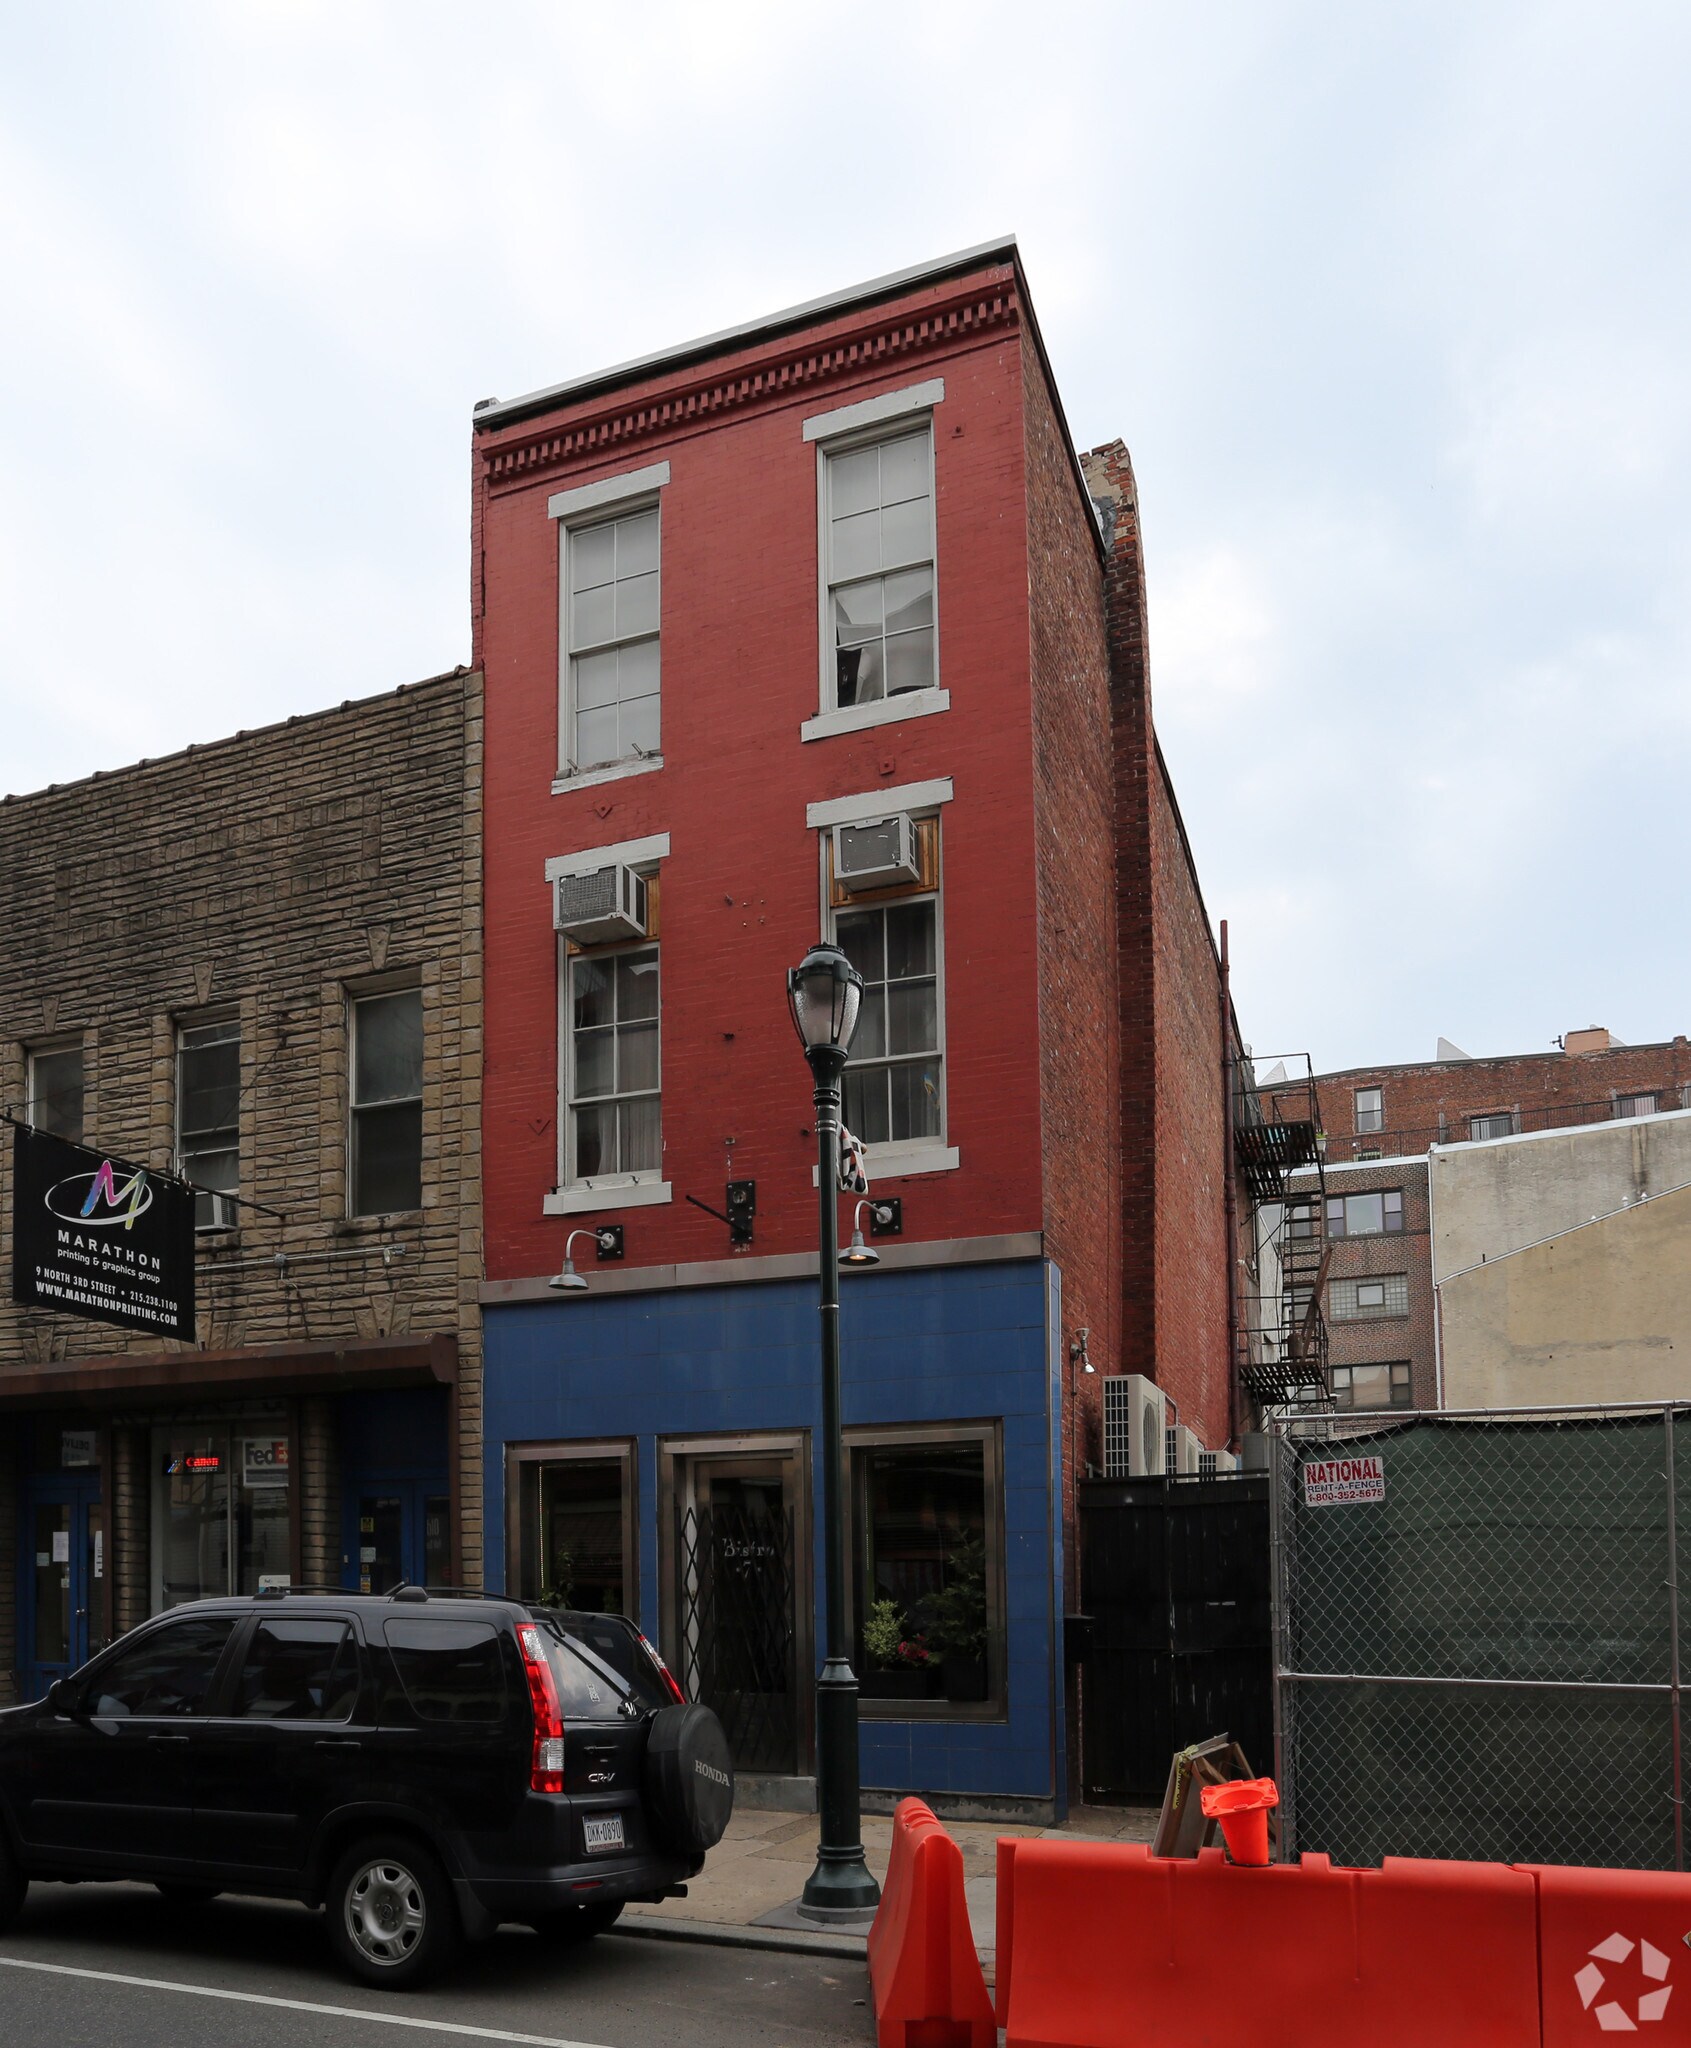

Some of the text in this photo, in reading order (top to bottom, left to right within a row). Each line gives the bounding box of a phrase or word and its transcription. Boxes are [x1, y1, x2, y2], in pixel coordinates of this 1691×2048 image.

[58, 1229, 160, 1270] MARATHON
[57, 1248, 161, 1284] printing & graphics group
[35, 1266, 178, 1311] 9 NORTH 3RD STREET 215.238.1100
[35, 1281, 178, 1326] WWW.MARATHONPRINTING.COM
[185, 1457, 219, 1467] Canon
[245, 1442, 288, 1465] FedE
[1306, 1458, 1382, 1485] NATIONAL
[1307, 1480, 1383, 1493] RENT-A-FENCE
[694, 1759, 731, 1787] HONDA
